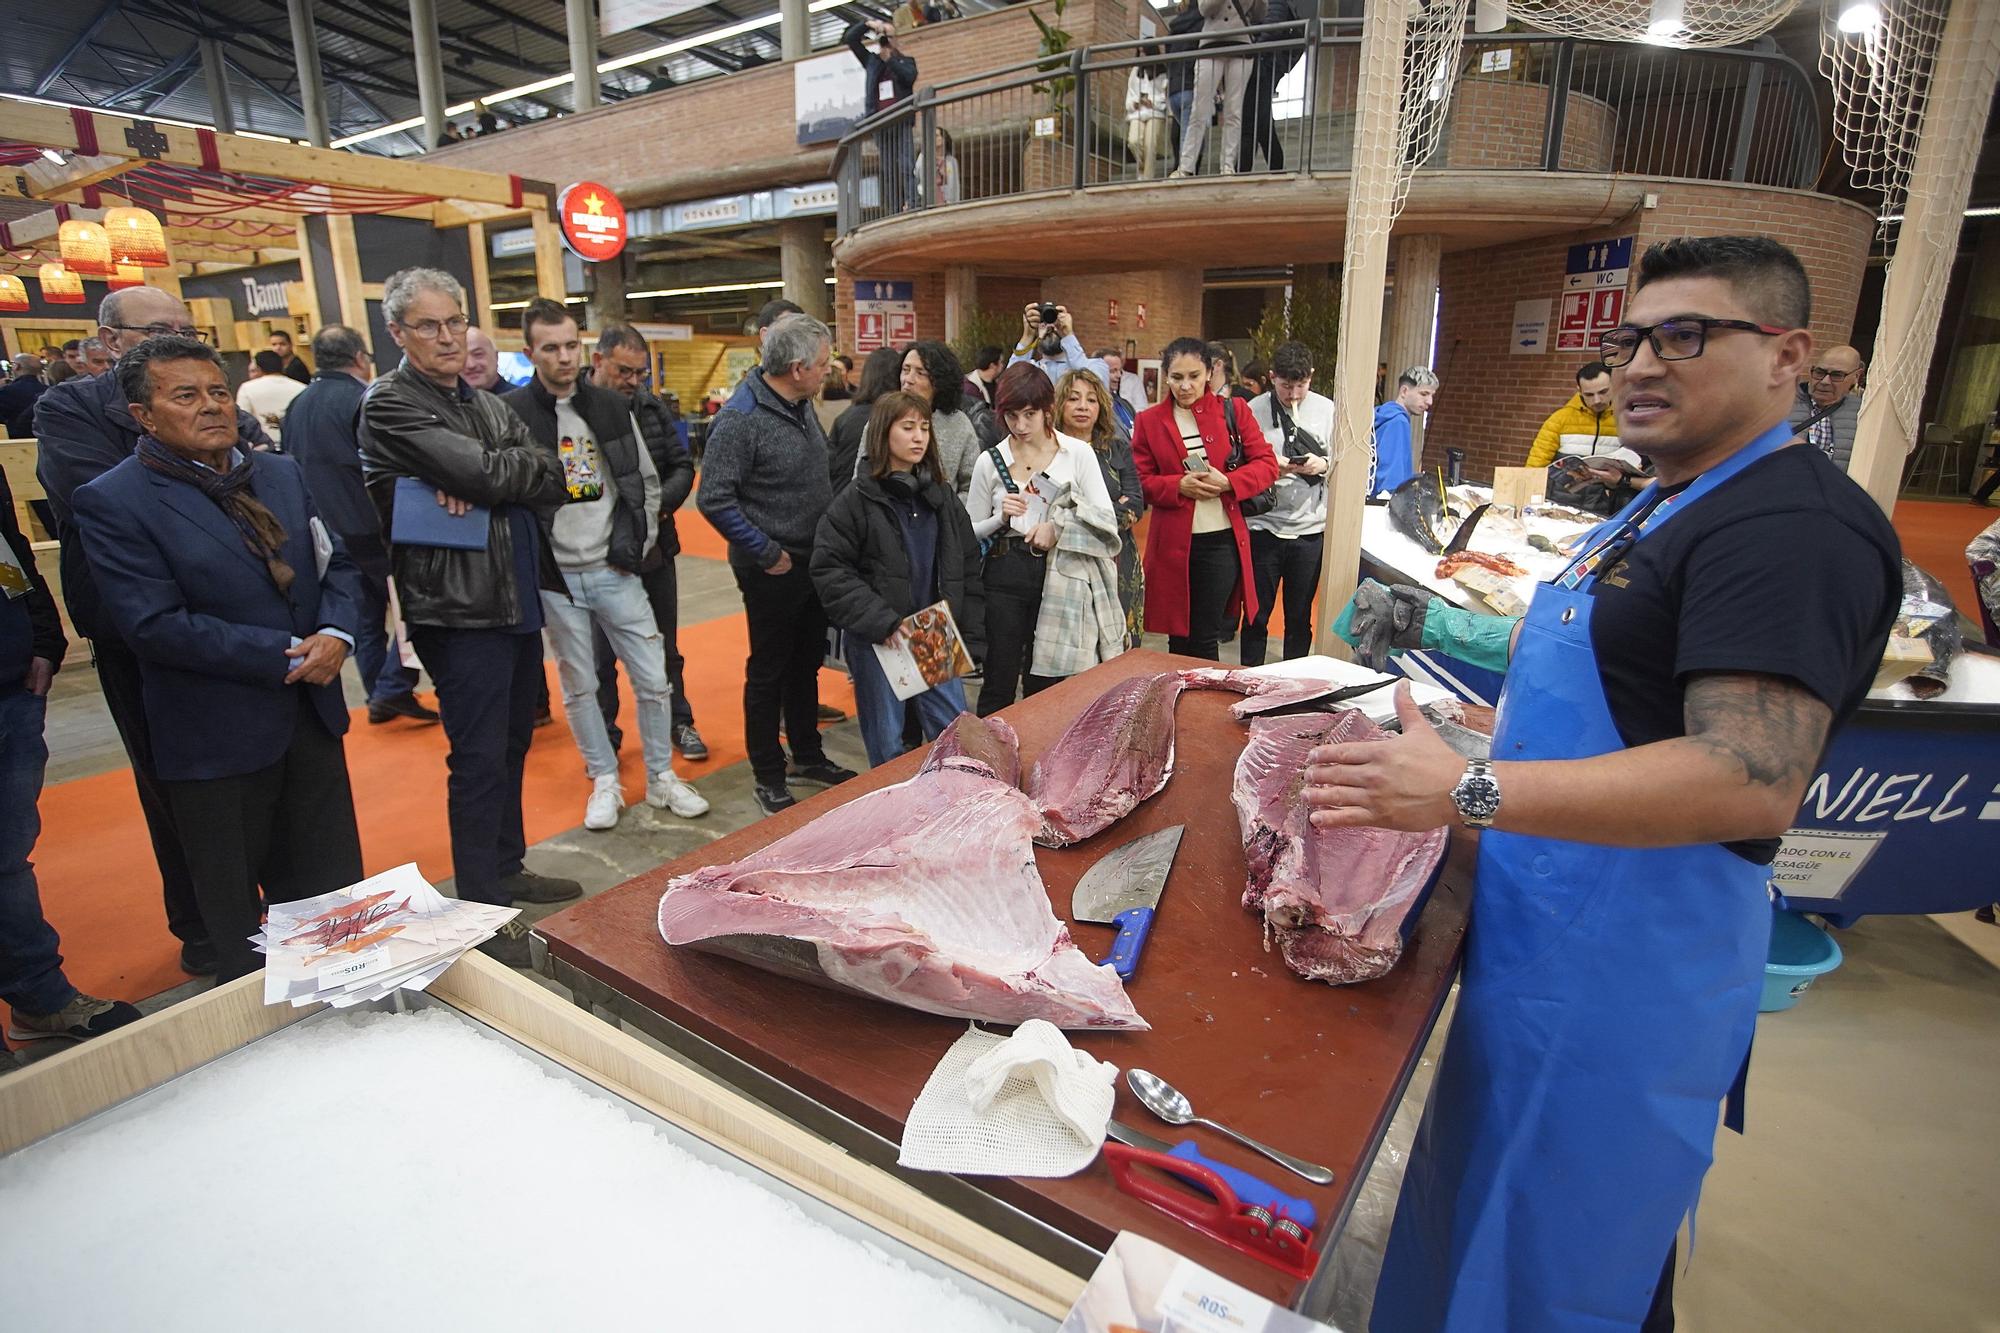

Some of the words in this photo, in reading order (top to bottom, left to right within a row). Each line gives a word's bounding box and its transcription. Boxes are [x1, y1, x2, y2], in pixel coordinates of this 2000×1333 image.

[1596, 272, 1614, 285] WC
[867, 302, 882, 310] WC
[1809, 849, 1837, 858] CON
[1838, 851, 1852, 859] EL
[344, 962, 367, 974] ROS
[1199, 1295, 1228, 1319] ROS
